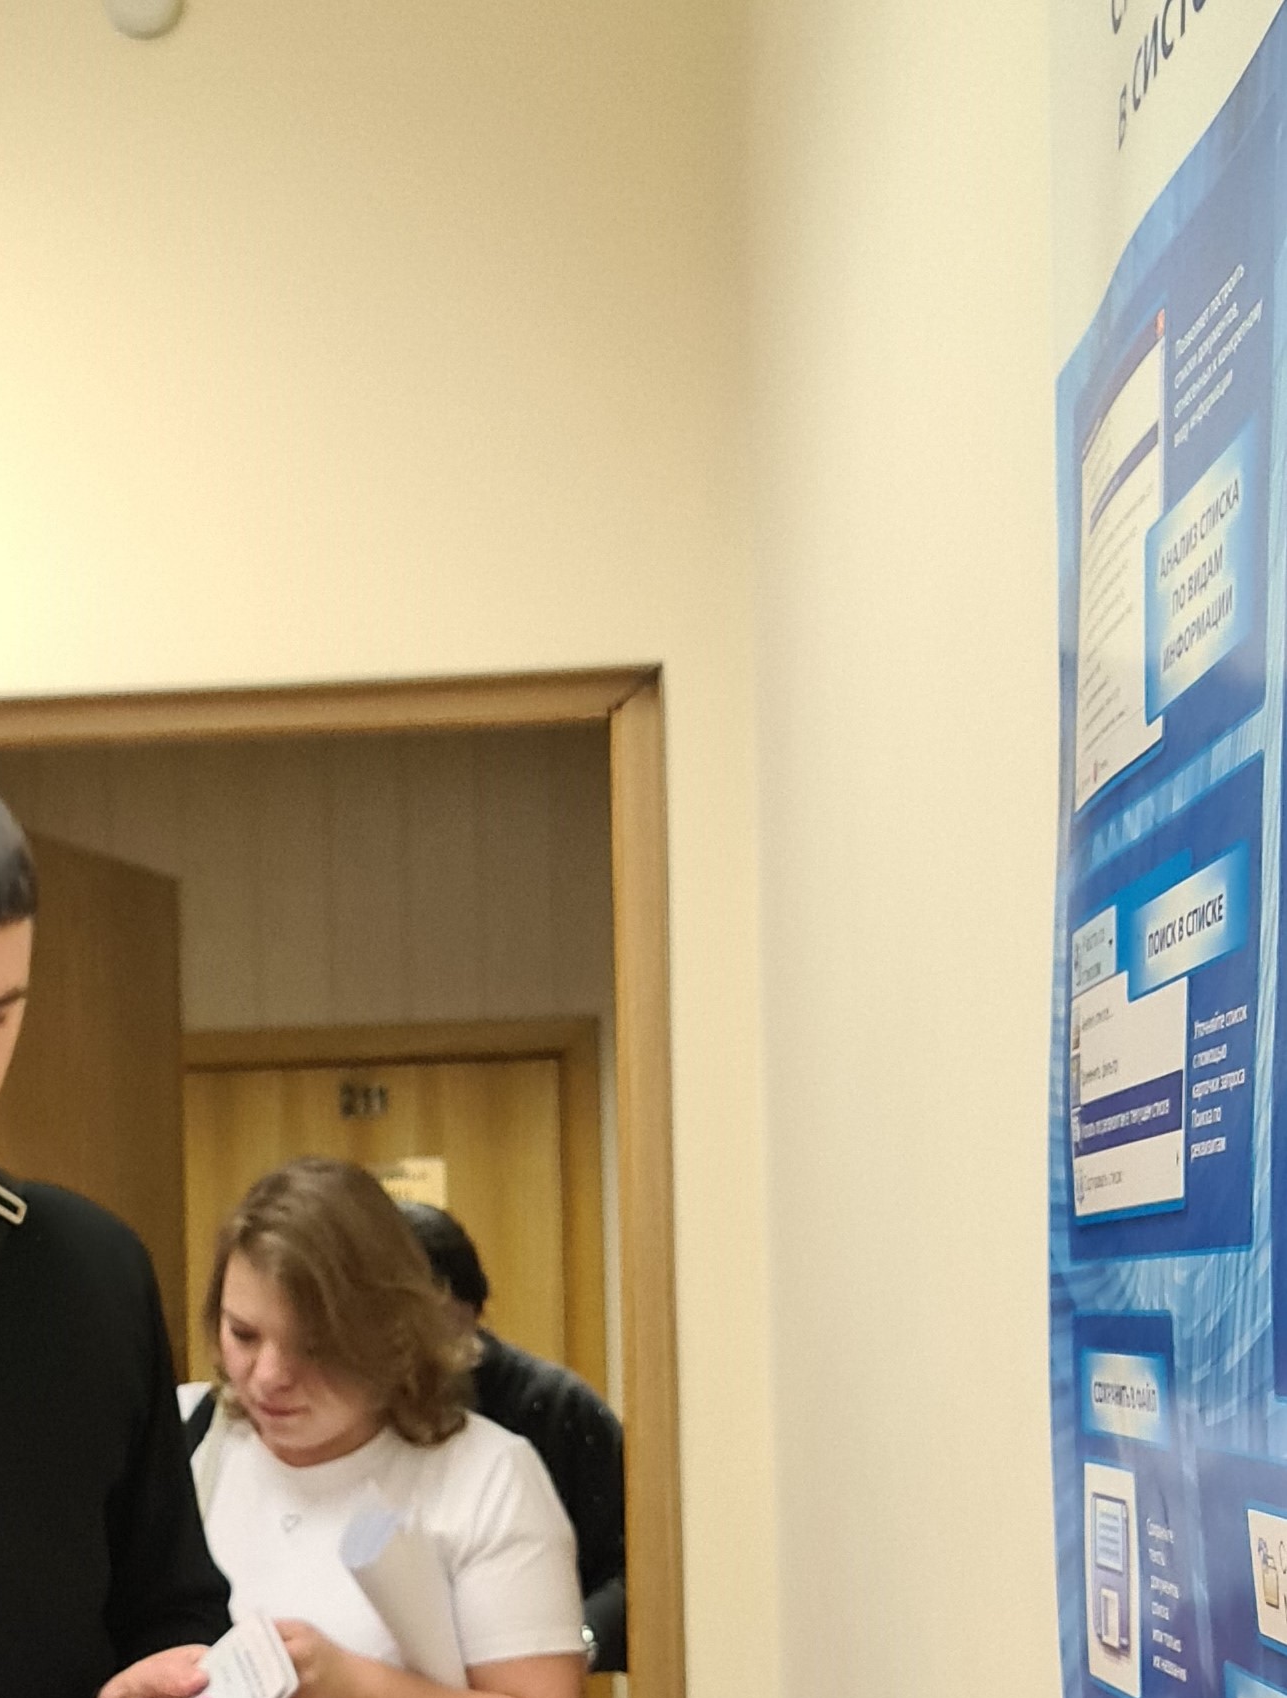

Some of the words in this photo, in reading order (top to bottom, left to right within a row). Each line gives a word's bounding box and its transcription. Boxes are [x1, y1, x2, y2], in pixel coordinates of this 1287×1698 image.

[1160, 521, 1198, 580] АНАЛИЗ
[1199, 479, 1240, 540] СПИСКА
[1171, 583, 1186, 617] ПО
[1187, 543, 1223, 601] ВИДАМ
[1161, 584, 1233, 673] ИНФОРМАЦИИ
[1147, 919, 1176, 959] ПОИСК
[1178, 915, 1184, 942] В
[1186, 893, 1224, 937] СПИСКЕ
